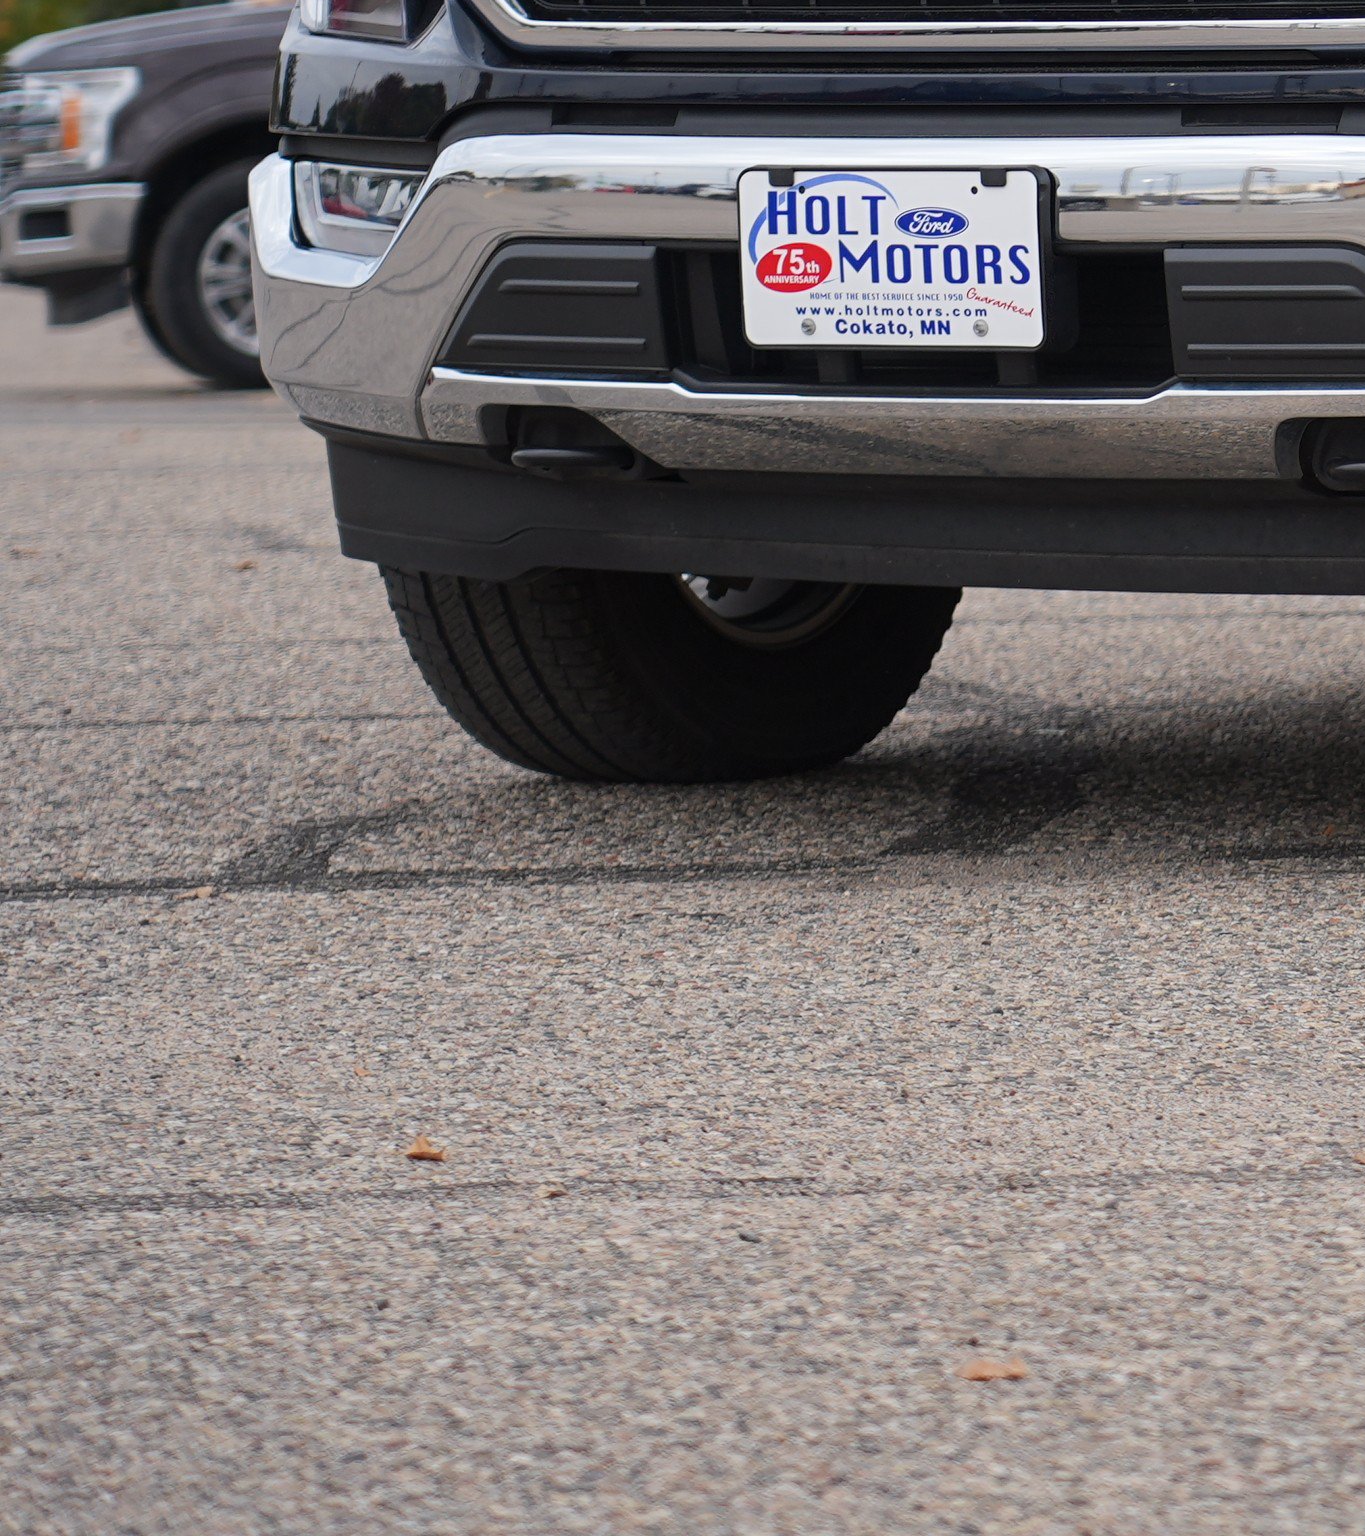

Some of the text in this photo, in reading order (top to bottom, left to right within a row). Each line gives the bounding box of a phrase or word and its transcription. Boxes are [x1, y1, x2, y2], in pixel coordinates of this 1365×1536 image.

[767, 191, 886, 235] HOLT
[908, 210, 955, 234] Ford
[772, 248, 820, 275] 75th
[838, 239, 1031, 285] MOTORS
[763, 275, 820, 285] ANNIVERSARY
[809, 292, 964, 302] HOME OF THE BEST SERVICE SINCE 1950
[966, 287, 1036, 318] Guaranteed
[795, 304, 987, 317] www.holtmotors.com
[835, 319, 951, 339] Cokato, MN
